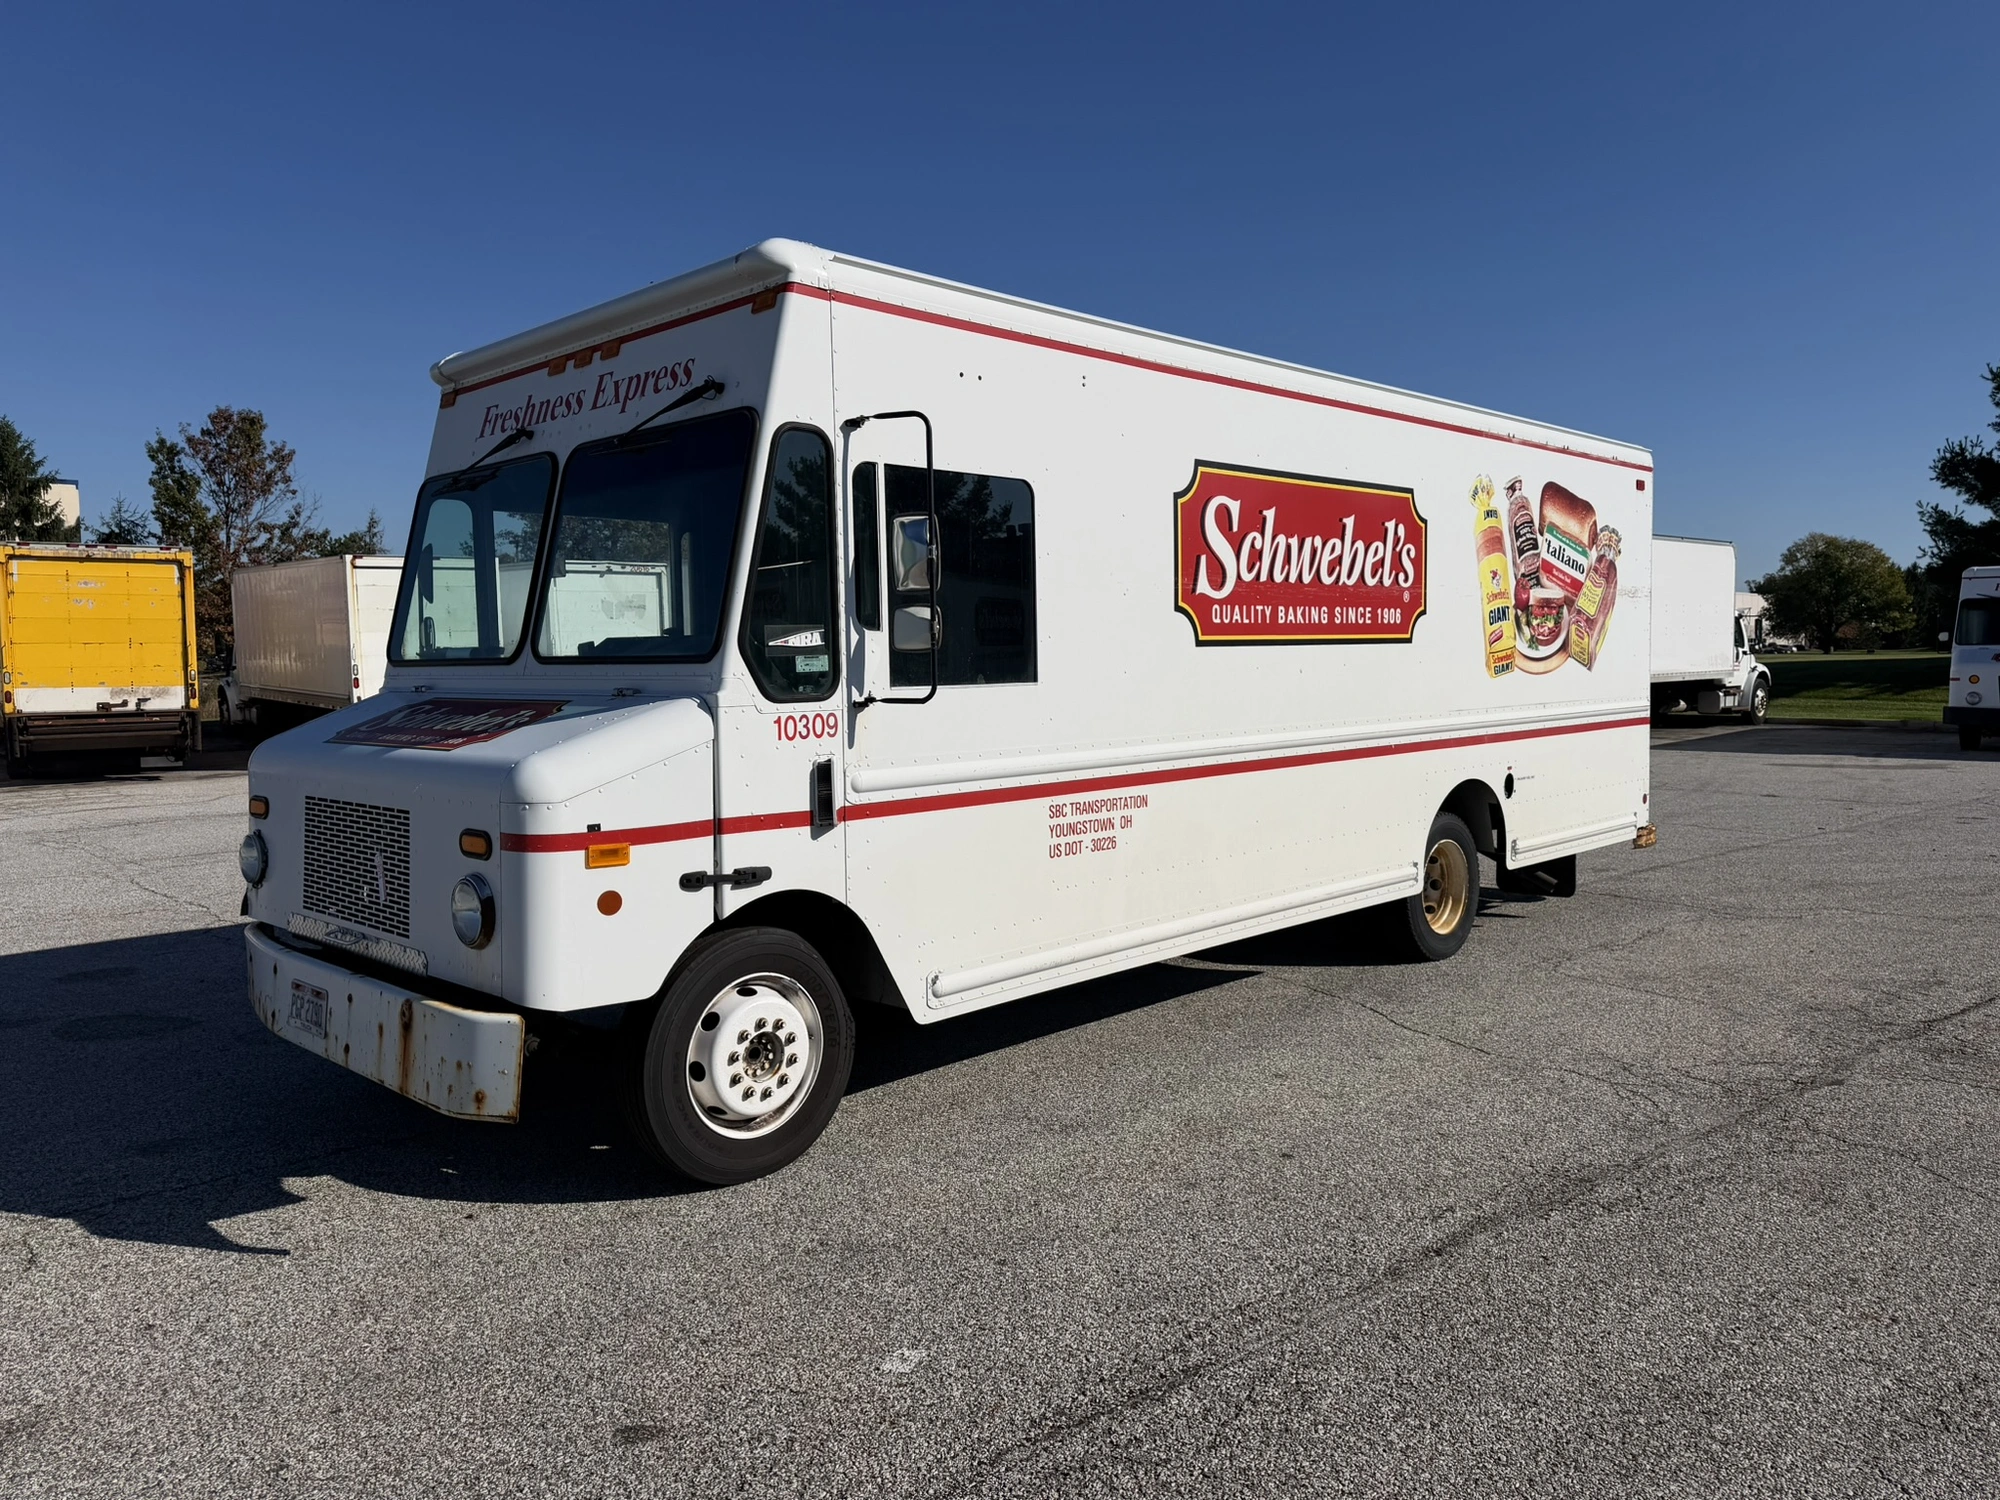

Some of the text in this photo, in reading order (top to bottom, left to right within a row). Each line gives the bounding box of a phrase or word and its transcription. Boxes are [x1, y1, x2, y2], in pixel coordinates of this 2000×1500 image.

[478, 357, 695, 439] Freshness Express
[1193, 495, 1416, 600] Schwebel's
[1211, 604, 1402, 624] QUALITY BAKING SINCE 1906
[1488, 605, 1510, 626] GIANT
[1493, 660, 1514, 675] GIANT
[773, 712, 839, 741] 10309
[1048, 794, 1149, 819] SBC TRANSPORTATION
[1048, 815, 1133, 839] YOUNGSTOWN OH
[1048, 843, 1063, 859] US
[1064, 840, 1084, 856] DOT
[1090, 836, 1117, 853] 30226
